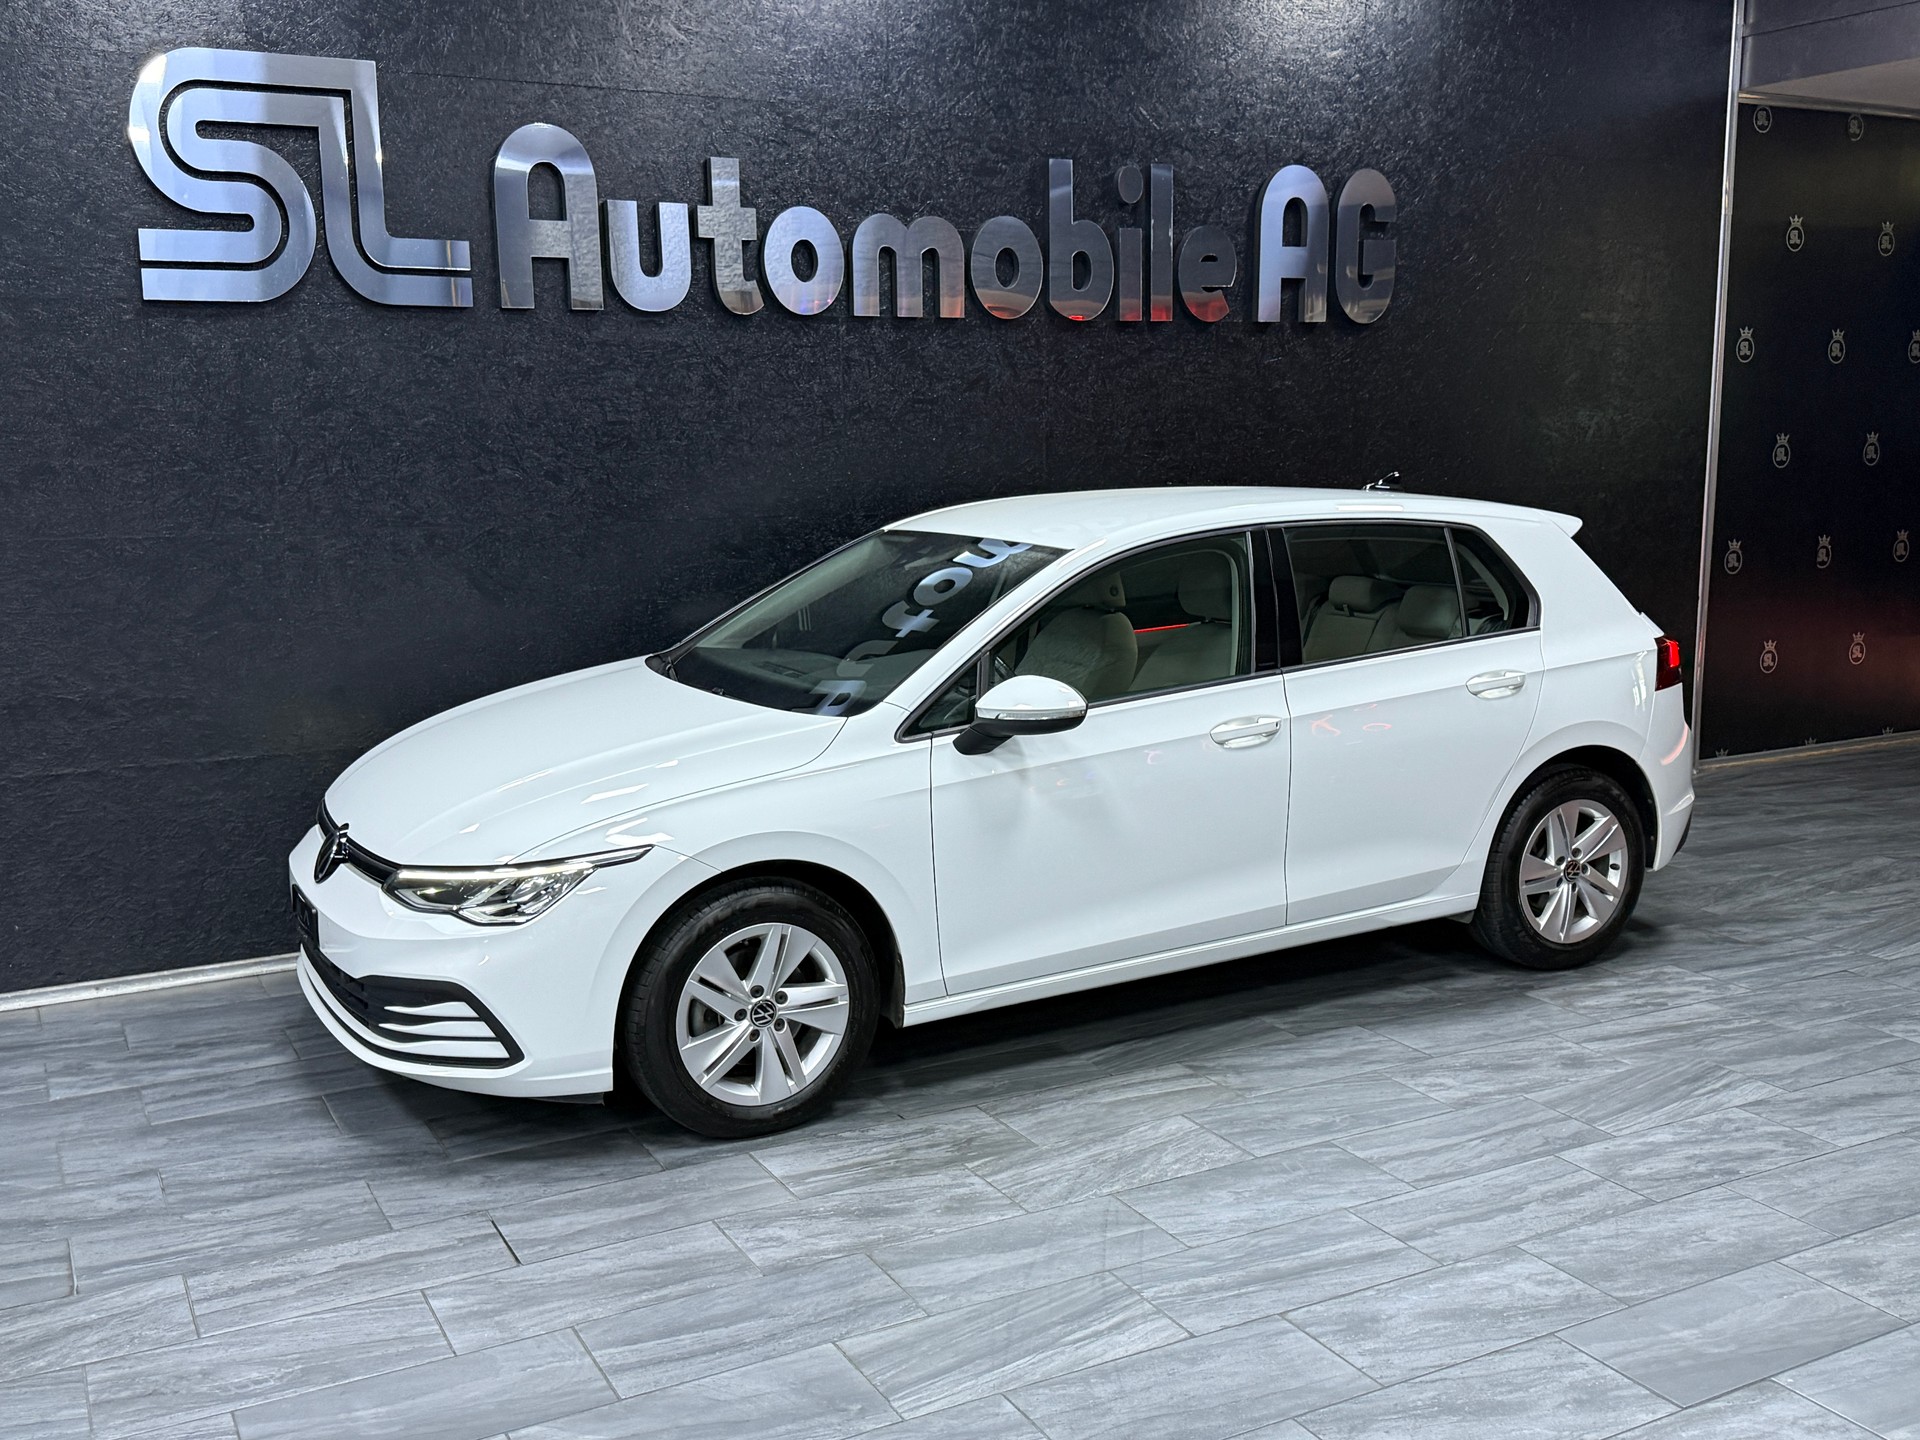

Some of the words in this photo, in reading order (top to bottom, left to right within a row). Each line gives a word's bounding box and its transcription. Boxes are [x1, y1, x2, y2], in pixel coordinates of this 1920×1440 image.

[128, 46, 473, 308] SL
[494, 122, 1238, 323] Automobile
[1256, 164, 1398, 324] AG
